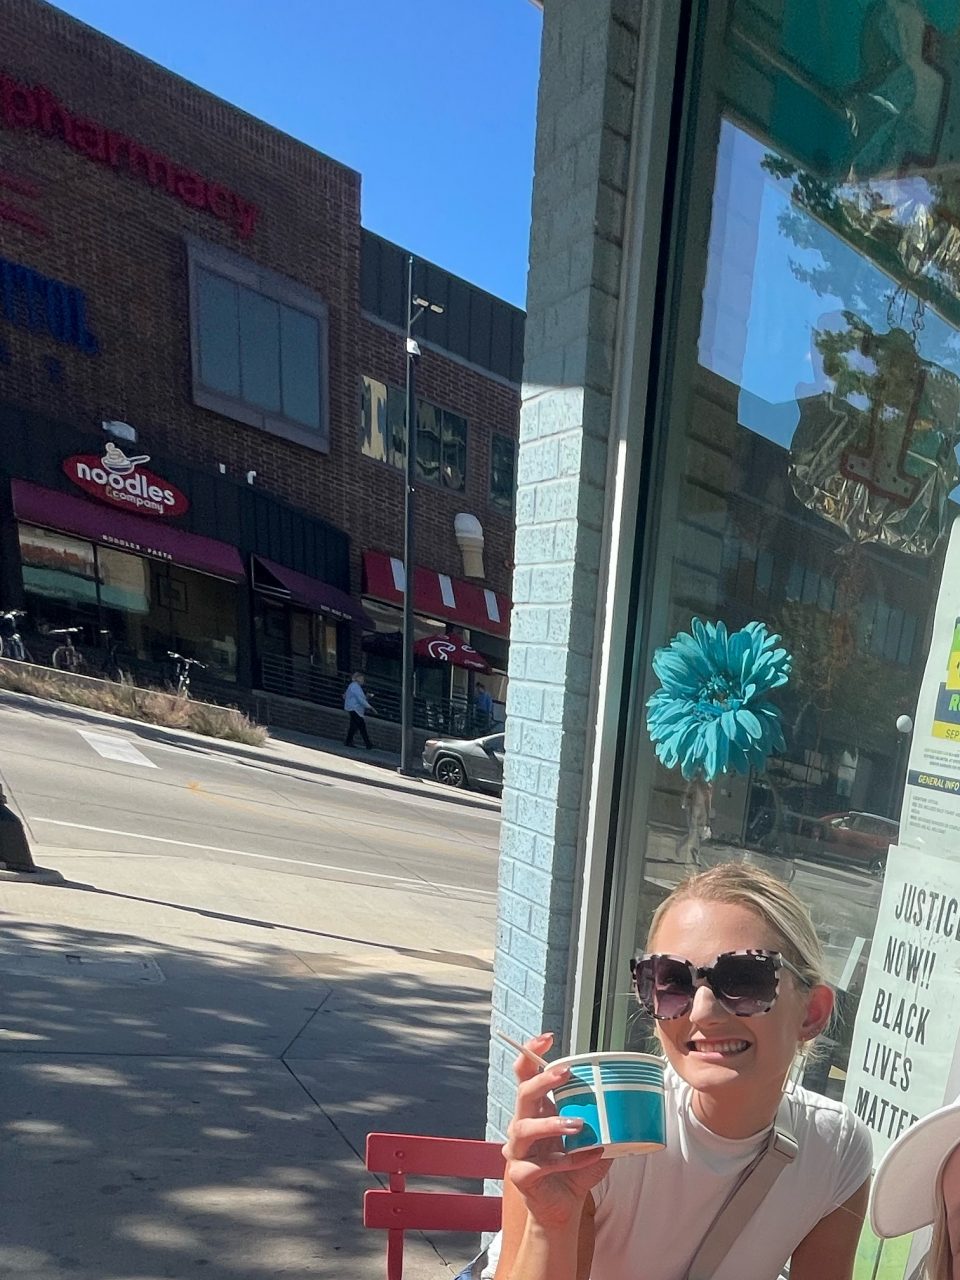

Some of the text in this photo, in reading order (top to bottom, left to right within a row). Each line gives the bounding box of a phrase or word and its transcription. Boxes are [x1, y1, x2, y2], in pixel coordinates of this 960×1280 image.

[0, 72, 258, 239] pharmacy
[77, 463, 175, 505] noodles
[918, 774, 960, 791] GENERAL INFO
[883, 936, 937, 990] NOW!!
[872, 988, 931, 1045] BLACK
[862, 1038, 912, 1092] LIVES
